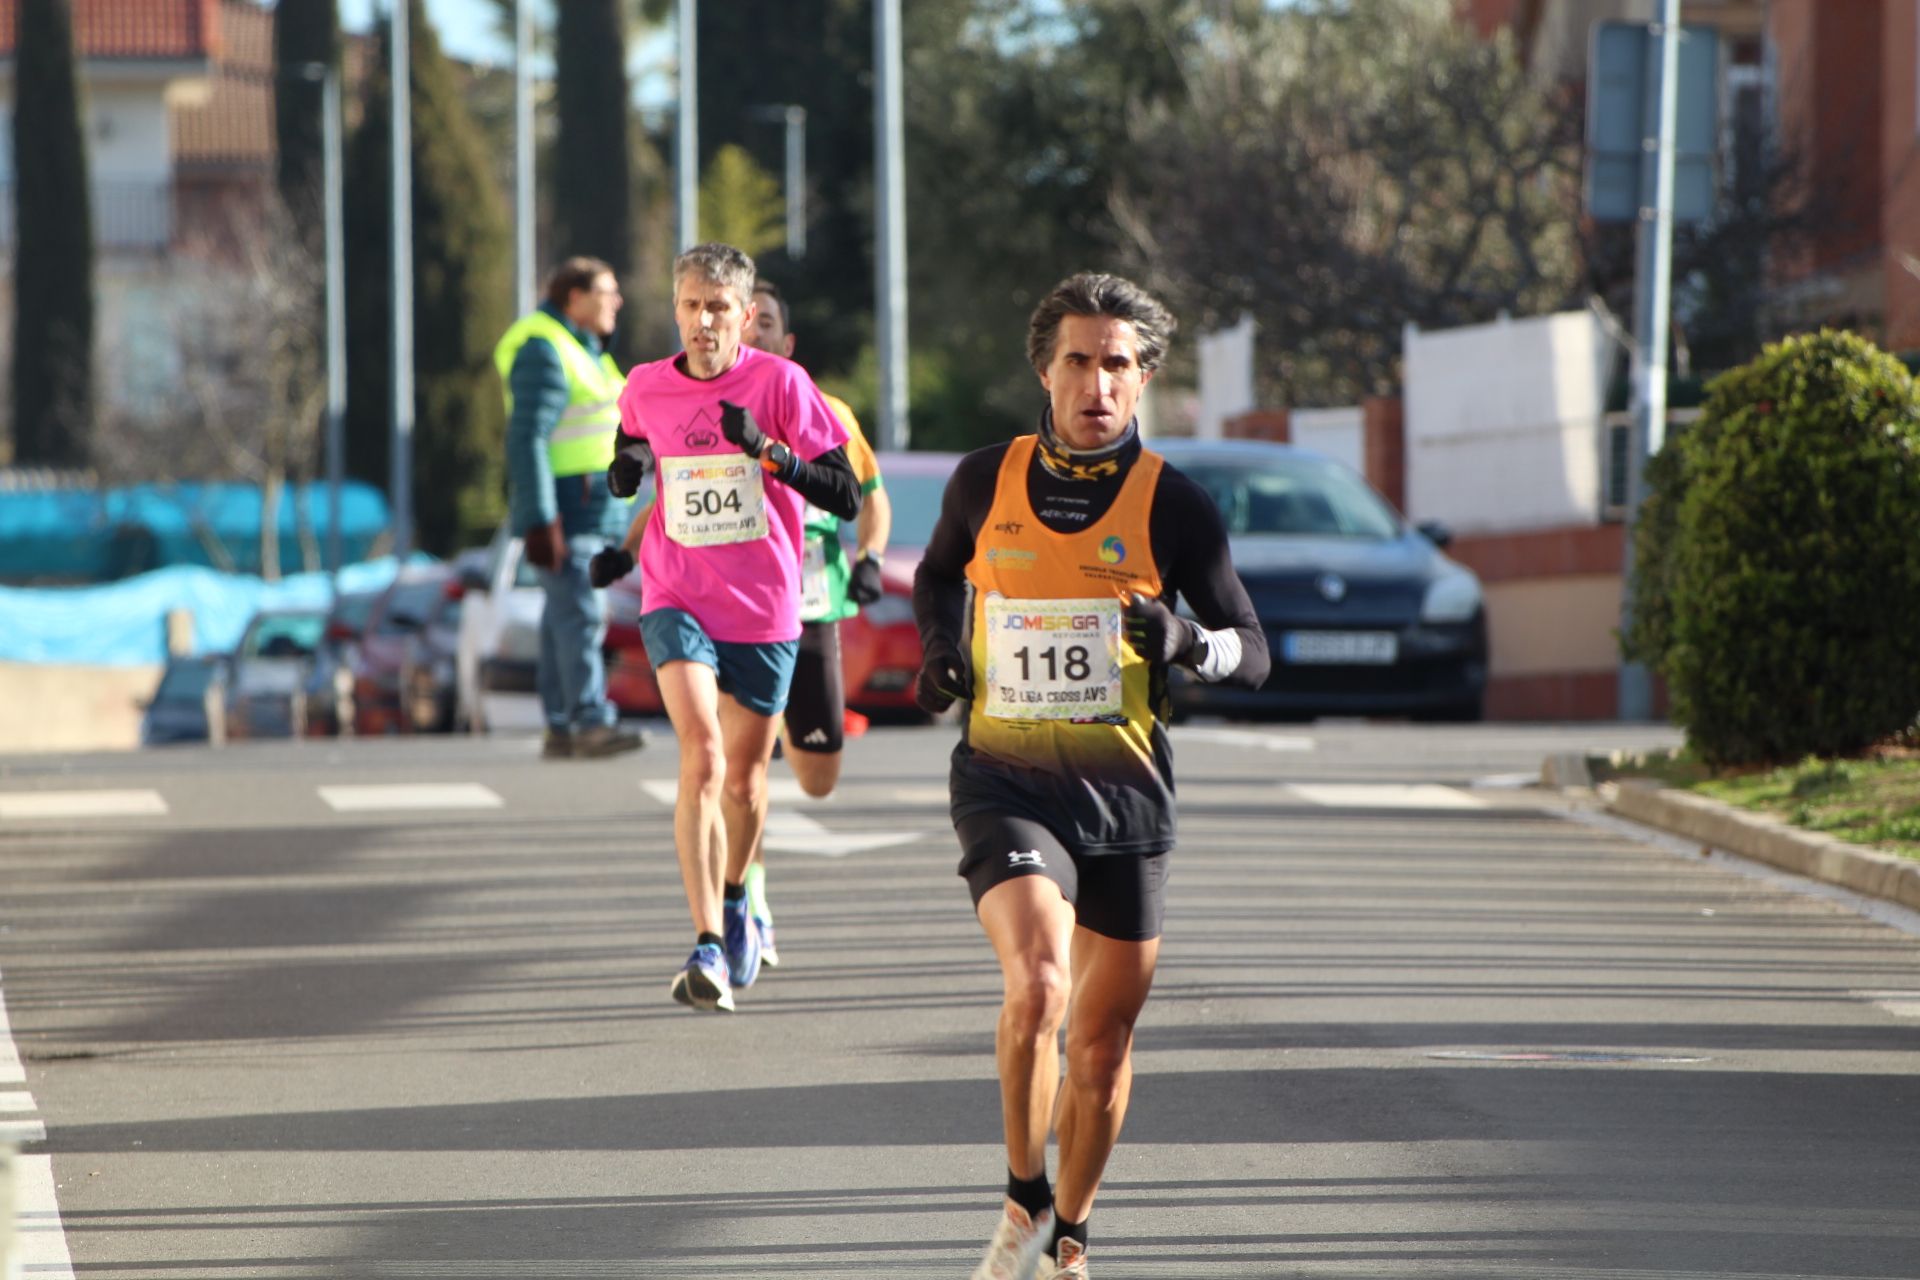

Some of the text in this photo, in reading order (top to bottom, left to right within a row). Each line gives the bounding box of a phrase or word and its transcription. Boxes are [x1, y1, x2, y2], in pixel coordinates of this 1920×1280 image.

[685, 488, 742, 516] 504
[677, 522, 688, 535] 32
[1003, 615, 1100, 630] JOMISAGA
[1013, 645, 1091, 681] 118
[1000, 686, 1108, 703] 32 LIGA CROSS AVS
